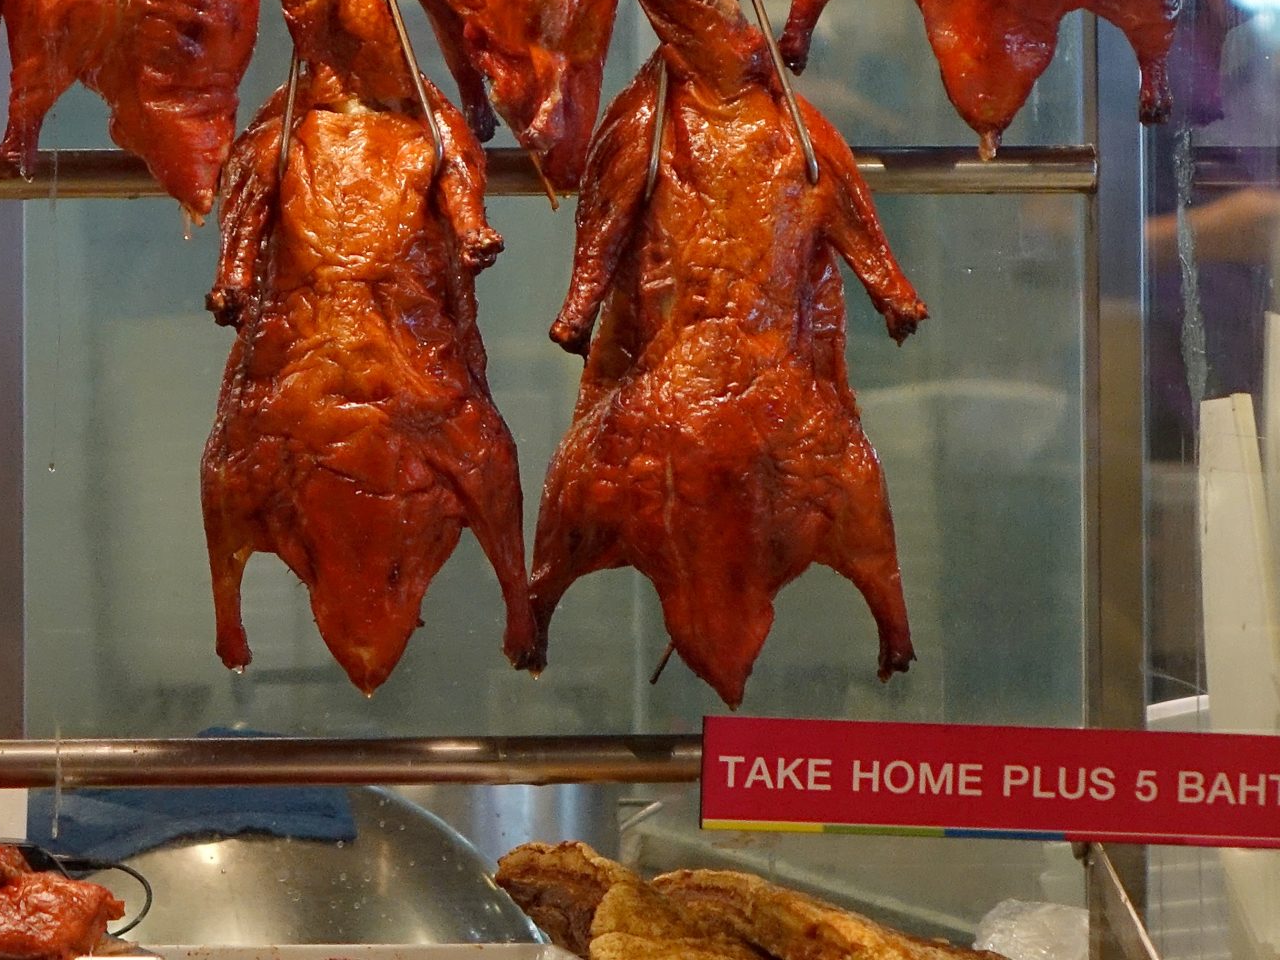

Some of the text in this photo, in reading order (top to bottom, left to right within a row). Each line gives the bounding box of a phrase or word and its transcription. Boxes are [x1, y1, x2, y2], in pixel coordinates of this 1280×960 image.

[719, 756, 832, 791] TAKE
[852, 760, 982, 796] HOME
[1002, 765, 1117, 800] PLUS
[1135, 771, 1158, 803] 5
